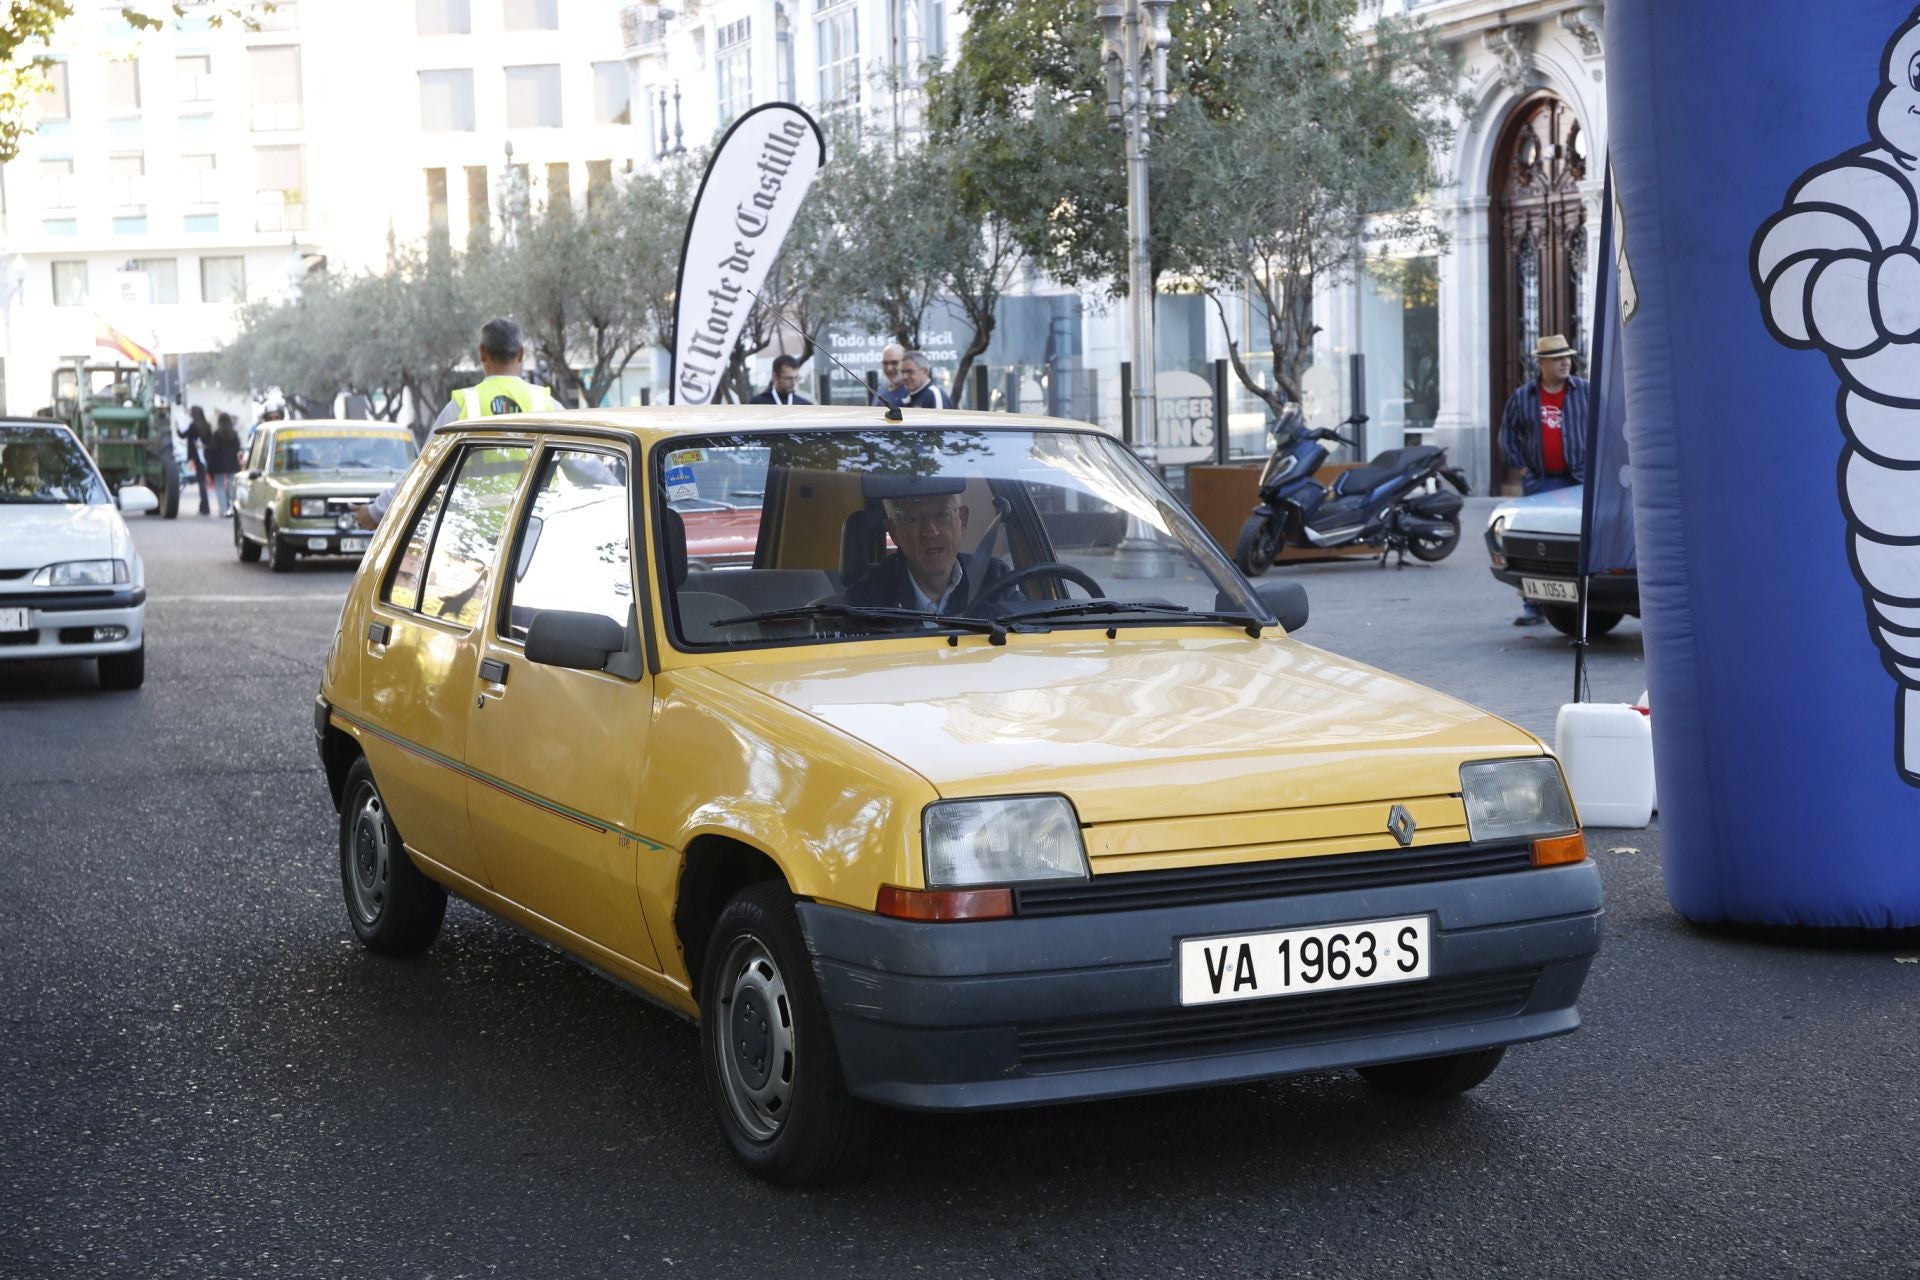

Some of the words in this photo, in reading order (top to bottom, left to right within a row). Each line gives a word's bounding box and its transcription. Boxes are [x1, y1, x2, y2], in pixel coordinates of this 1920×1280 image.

[735, 120, 807, 238] Castilla
[718, 241, 755, 273] de
[688, 277, 742, 359] Norte
[829, 333, 865, 347] Todo
[867, 335, 885, 346] es
[830, 349, 883, 364] cuando
[680, 362, 716, 404] El
[1158, 418, 1214, 446] ING
[1525, 580, 1539, 596] VA
[1543, 582, 1566, 598] 1053
[1571, 583, 1577, 599] J
[1204, 943, 1257, 994] VA
[1278, 931, 1377, 987] 1963
[1396, 926, 1419, 973] S
